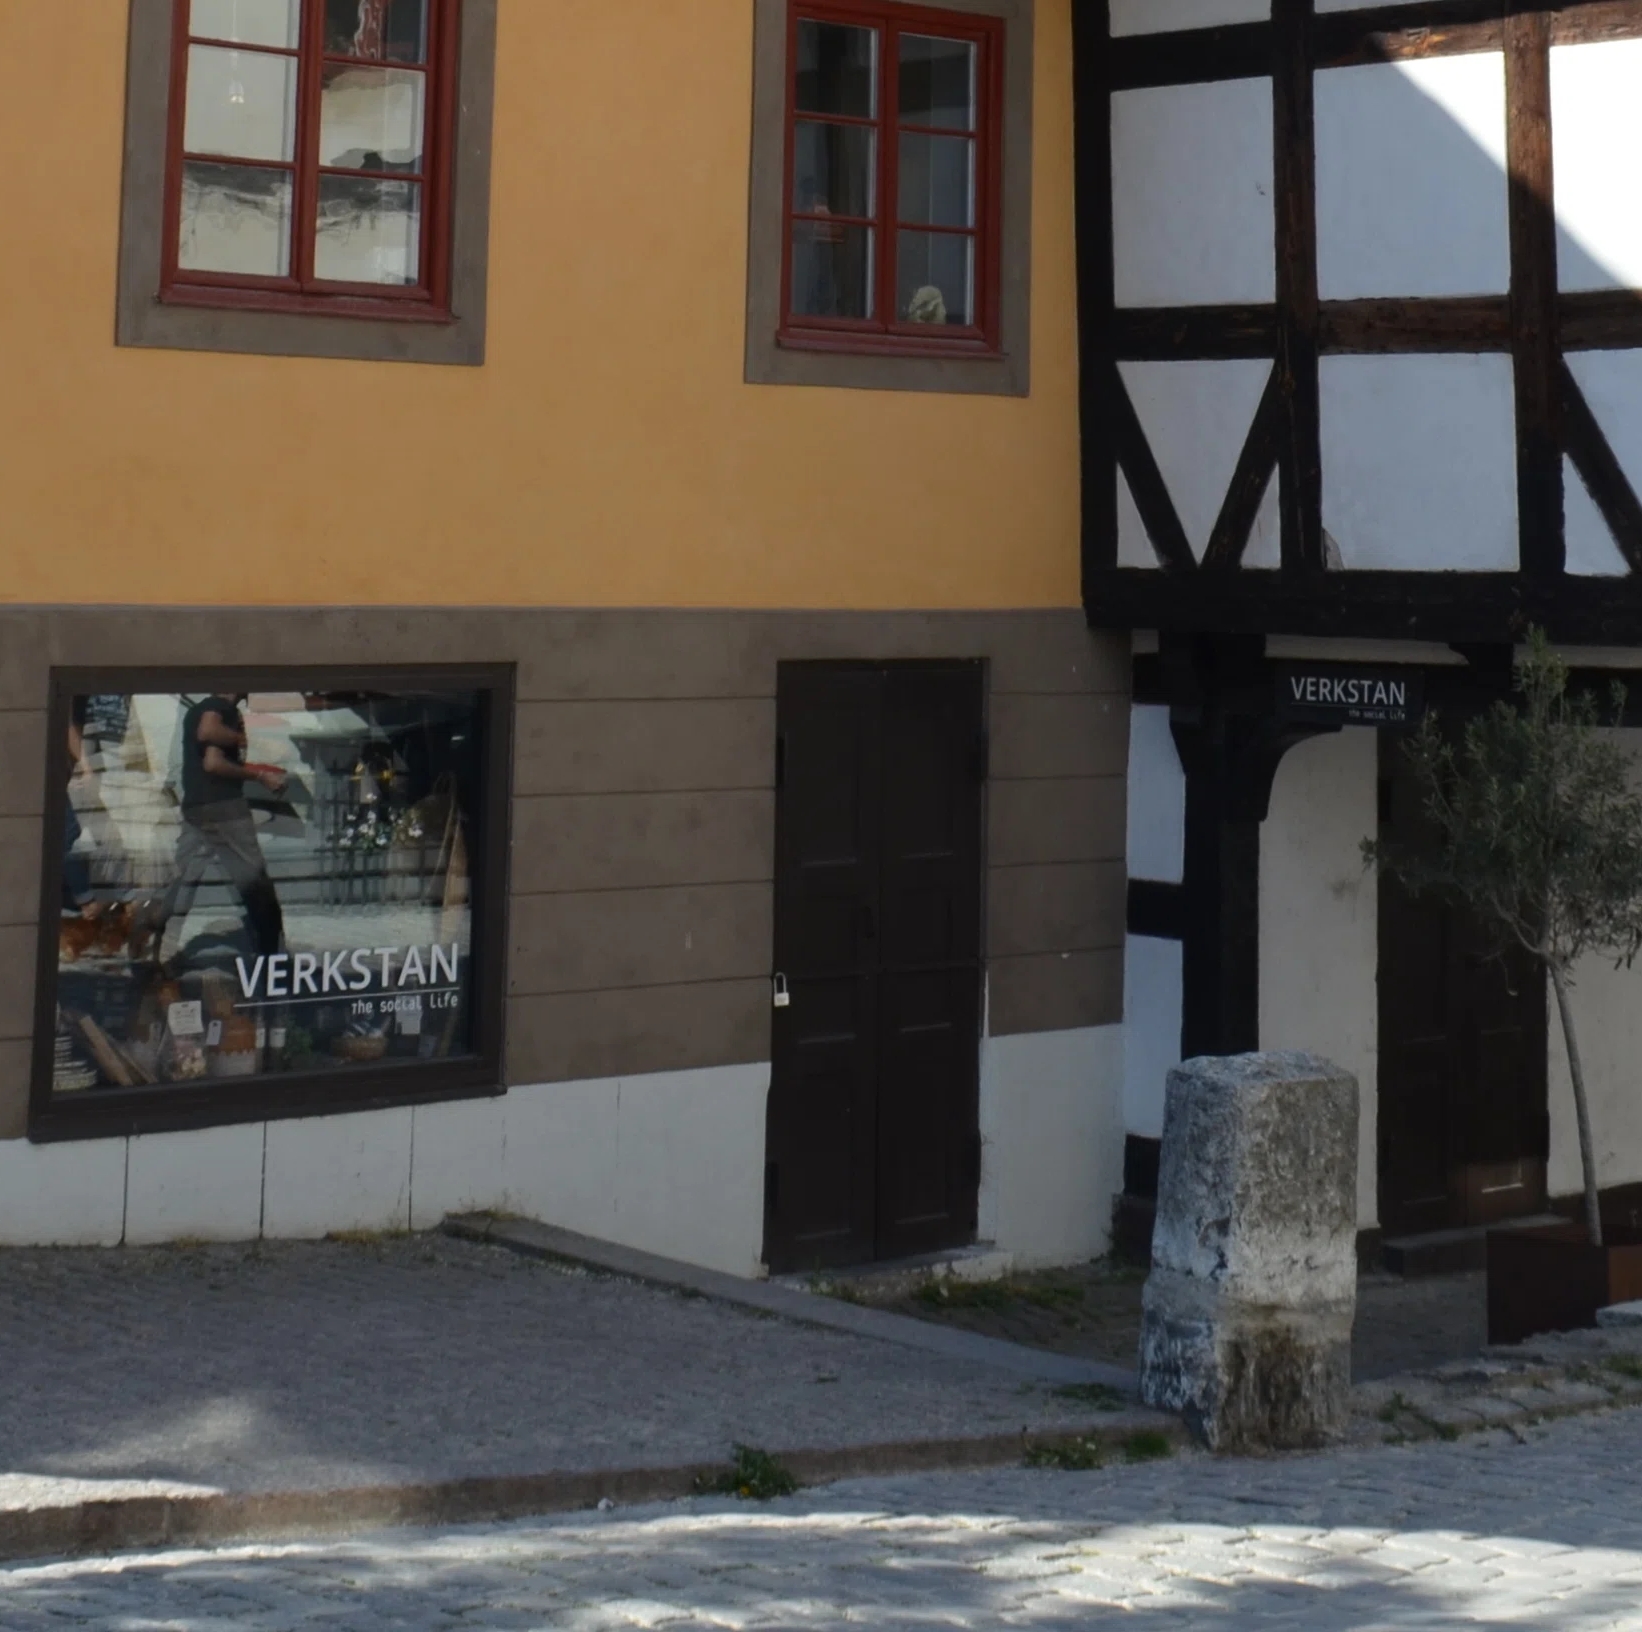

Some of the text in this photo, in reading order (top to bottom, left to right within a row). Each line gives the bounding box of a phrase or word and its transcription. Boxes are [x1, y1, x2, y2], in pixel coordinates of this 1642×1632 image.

[1290, 675, 1406, 706] VERKSTAN
[234, 942, 459, 999] VERKSTAN
[380, 994, 422, 1013] social
[429, 991, 459, 1009] life
